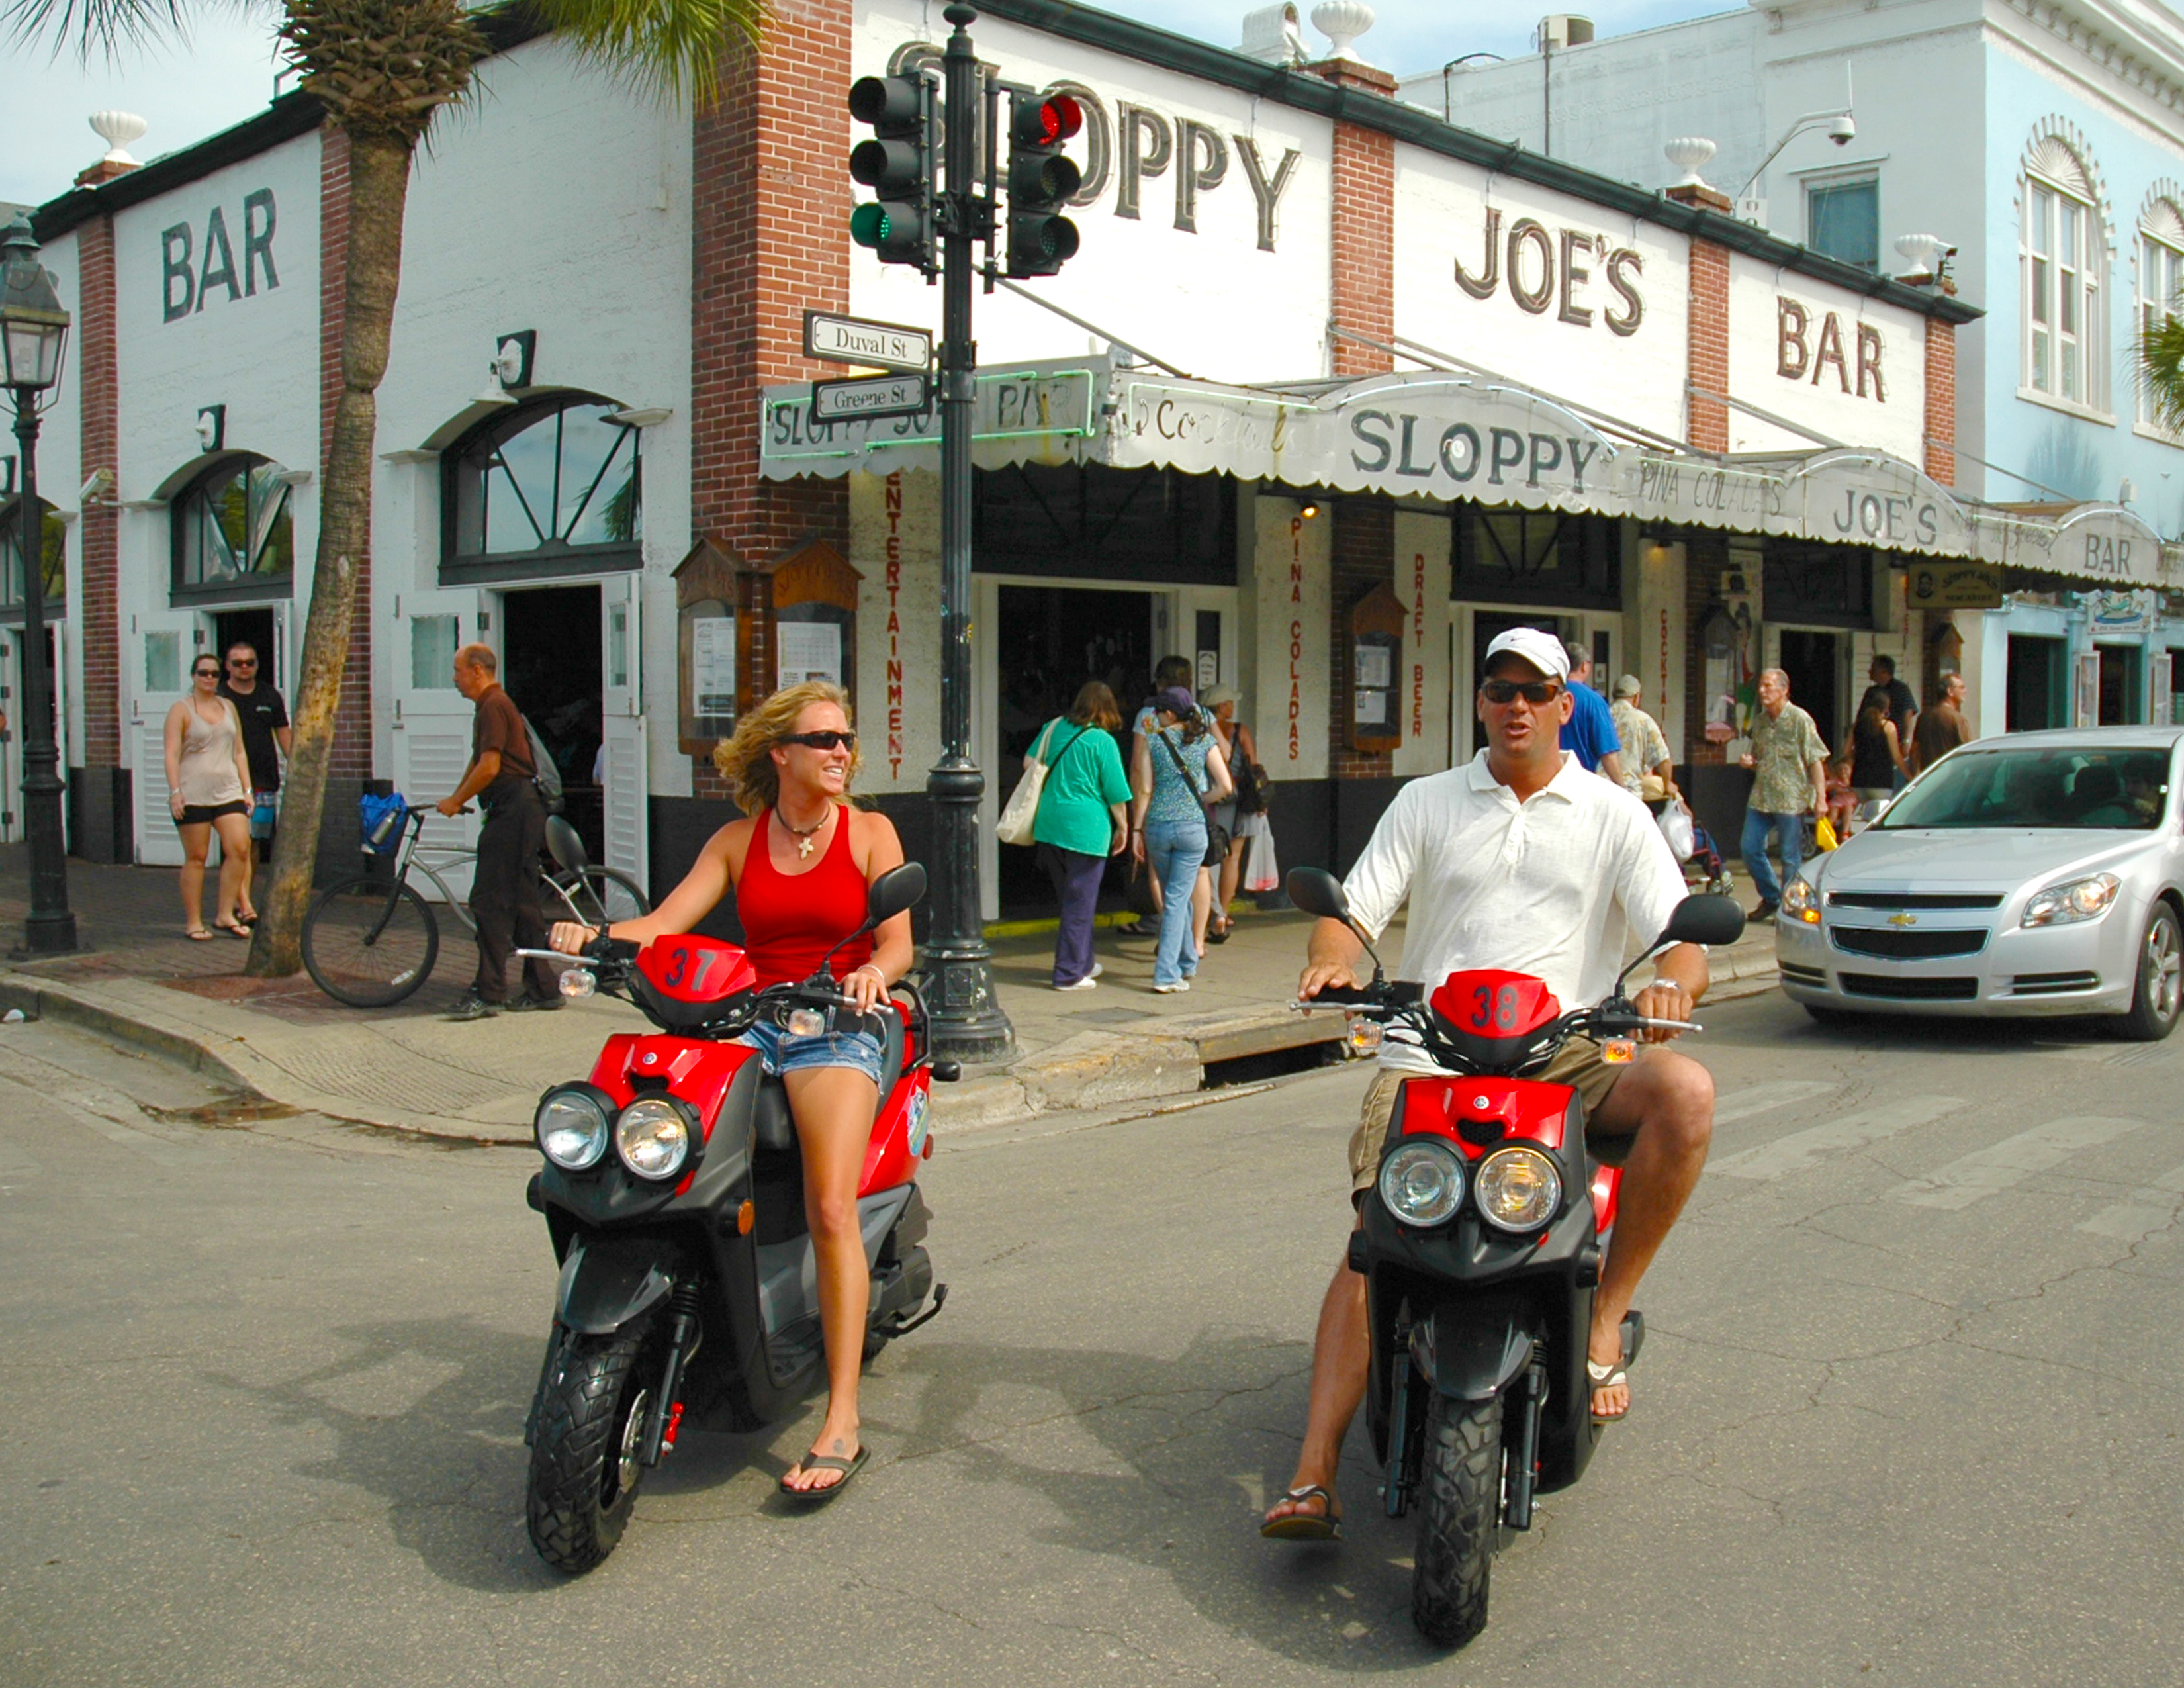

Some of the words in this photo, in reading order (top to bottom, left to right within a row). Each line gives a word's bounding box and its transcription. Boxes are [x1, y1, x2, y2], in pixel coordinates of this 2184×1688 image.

[162, 187, 280, 324] BAR
[1455, 206, 1647, 336] JOE'S
[835, 328, 885, 355] Duval
[891, 338, 907, 358] St
[1777, 295, 1888, 402] BAR
[834, 389, 886, 408] Greene
[890, 385, 907, 402] St
[1351, 409, 1600, 494] SLOPPY
[1833, 489, 1937, 545] JOE'S
[2084, 532, 2131, 575] BAR
[886, 471, 903, 780] ENTERTAINMENT
[1412, 553, 1424, 648] DRAFT
[1289, 620, 1301, 761] COLADAS
[1412, 665, 1424, 737] BEER
[666, 947, 716, 992] 37
[1471, 985, 1520, 1029] 38
